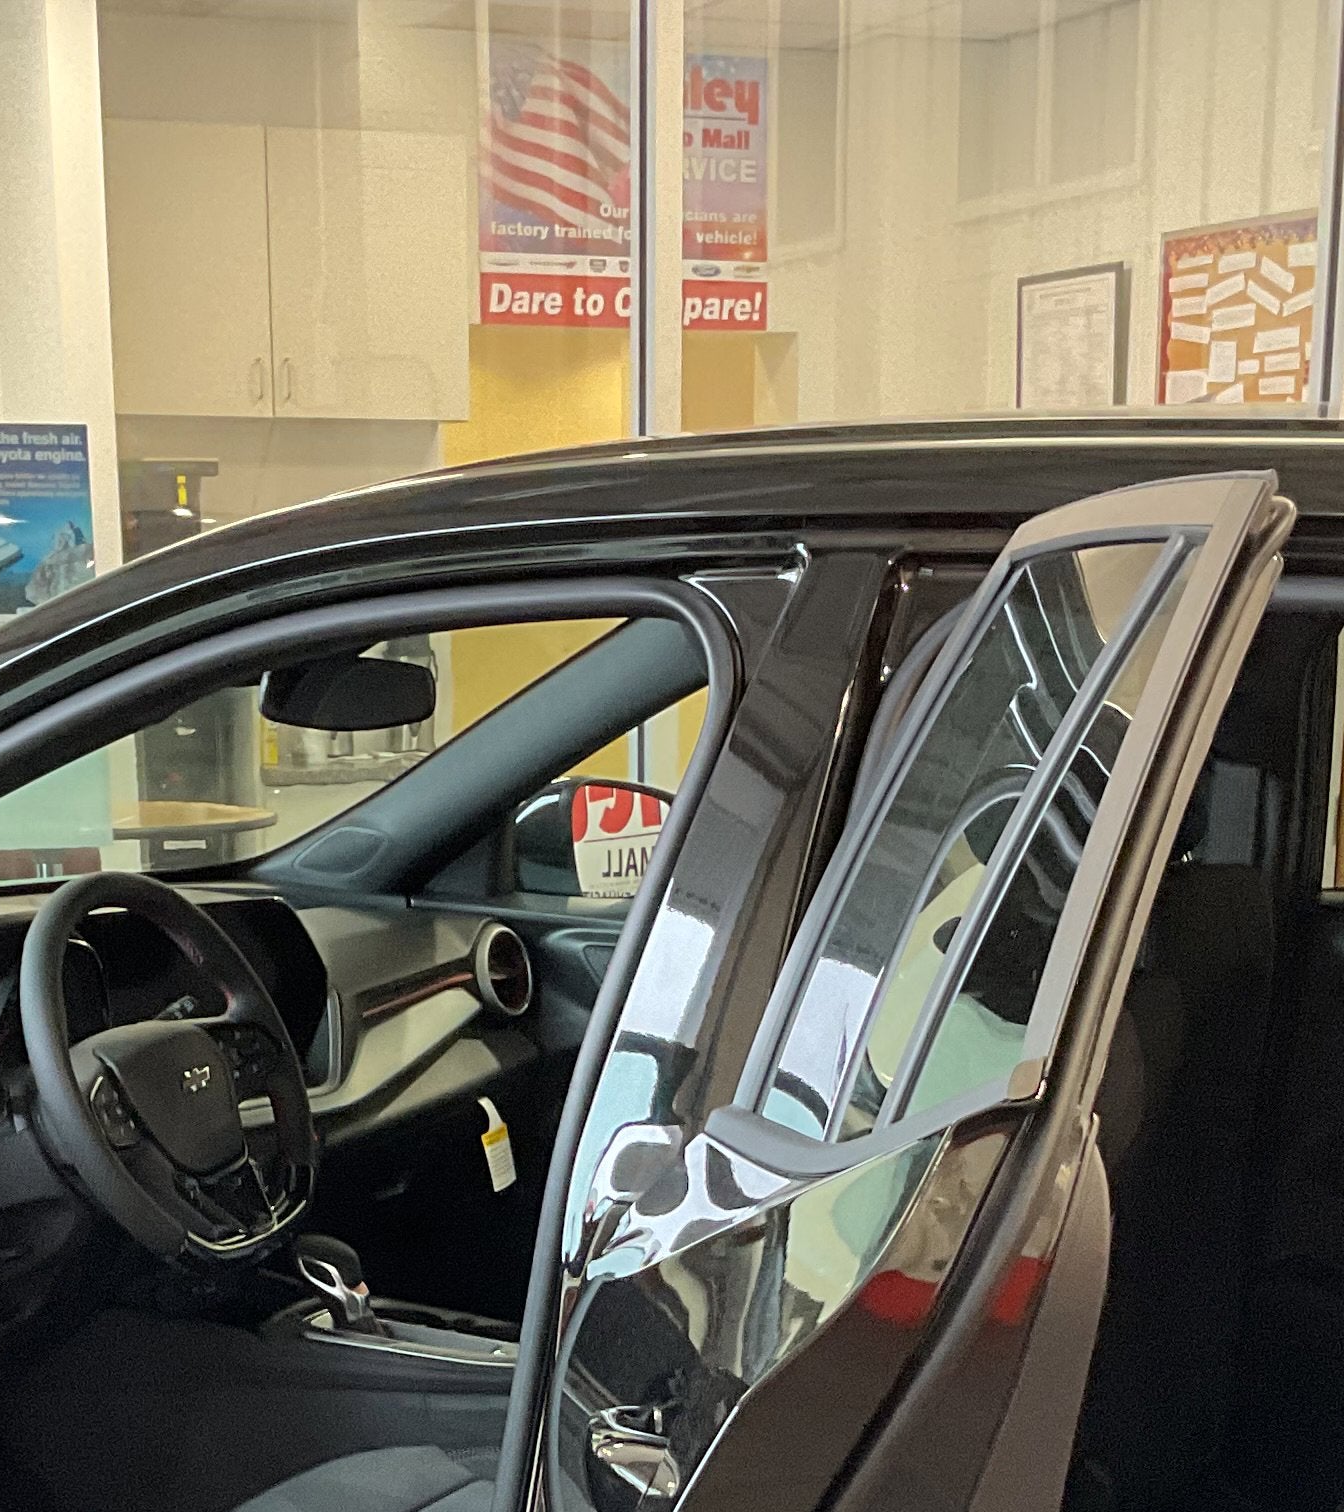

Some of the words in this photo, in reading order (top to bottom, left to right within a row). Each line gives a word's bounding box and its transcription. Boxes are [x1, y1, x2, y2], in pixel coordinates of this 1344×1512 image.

[702, 128, 750, 149] Mall
[684, 157, 757, 182] VICE
[600, 204, 629, 218] Our
[491, 221, 549, 240] factory
[554, 225, 614, 239] trained
[489, 283, 563, 315] Dare
[573, 287, 605, 315] to
[22, 432, 58, 445] fresh
[62, 433, 83, 445] air.
[35, 449, 86, 464] engine.
